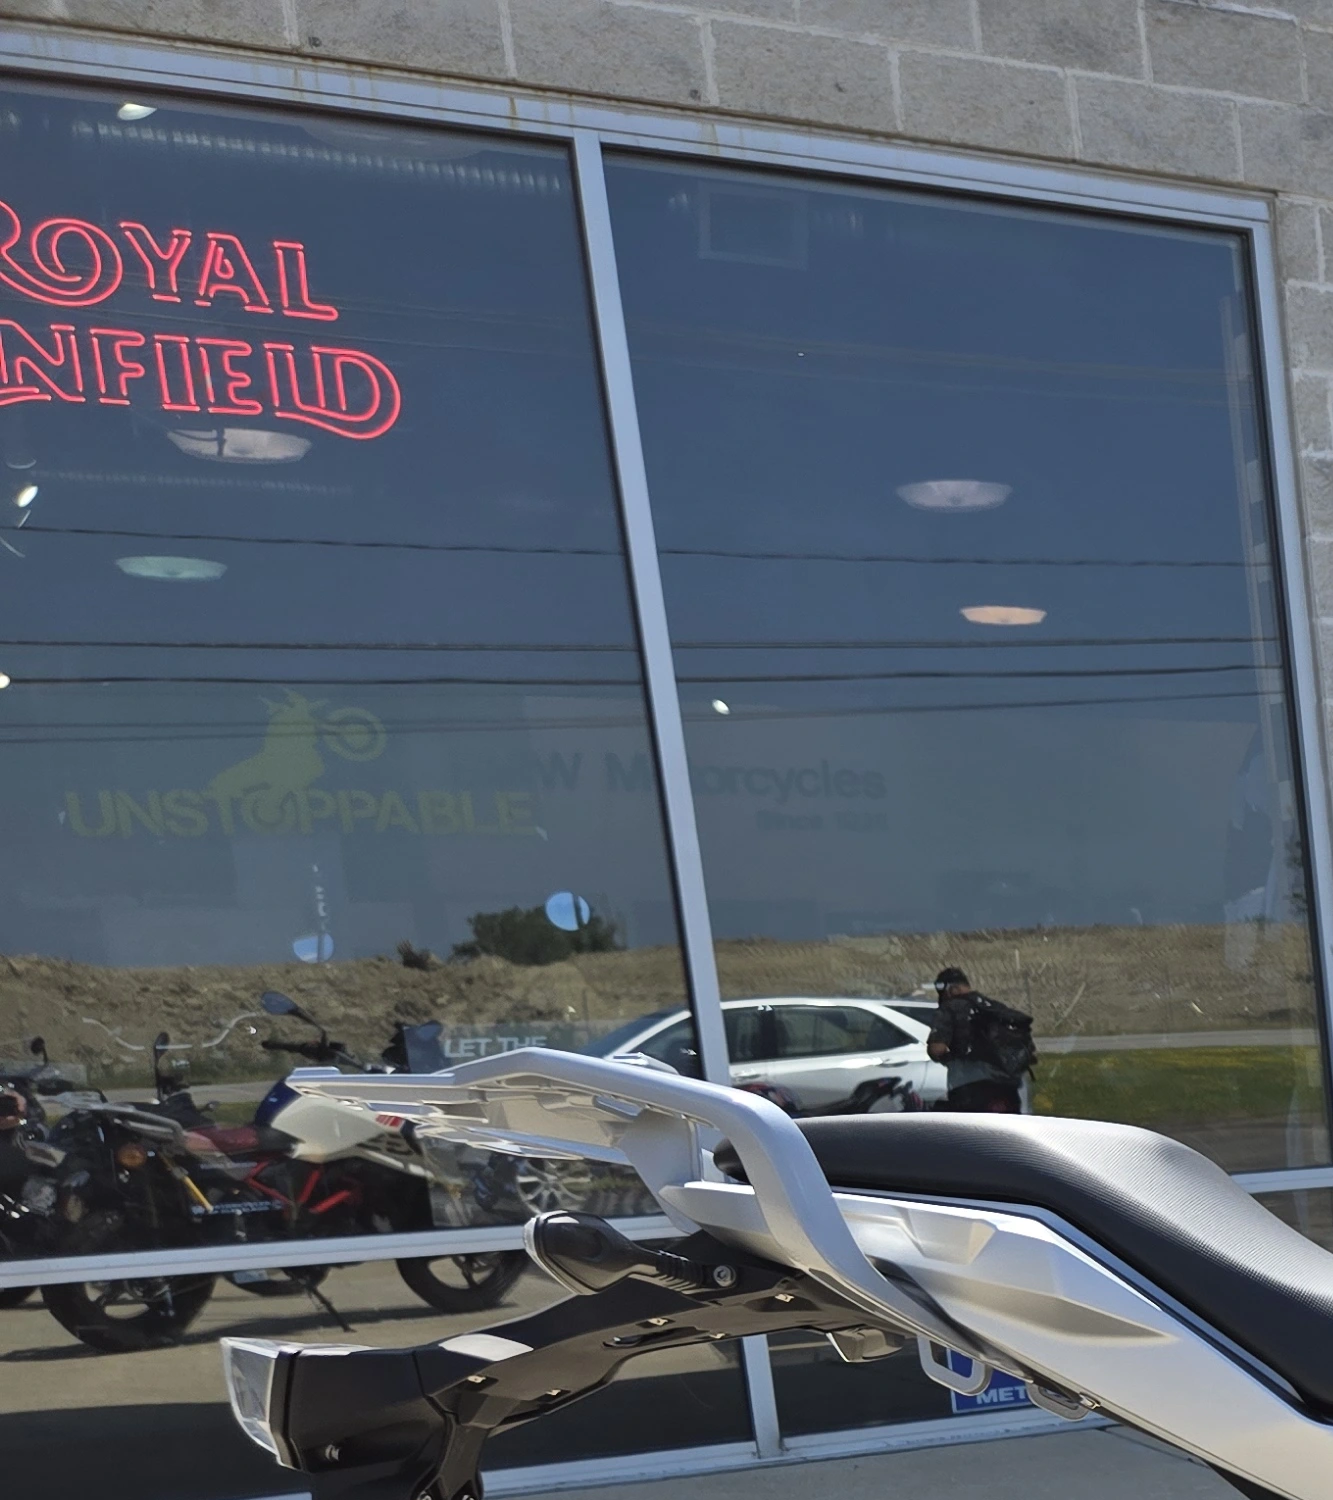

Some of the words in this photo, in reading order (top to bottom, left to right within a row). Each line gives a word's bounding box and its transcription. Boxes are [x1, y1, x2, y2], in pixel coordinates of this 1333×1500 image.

[0, 318, 402, 440] NFIELD
[604, 752, 888, 803] Morcycles
[64, 788, 541, 838] UNSTOPPABLE
[444, 1038, 492, 1058] LET
